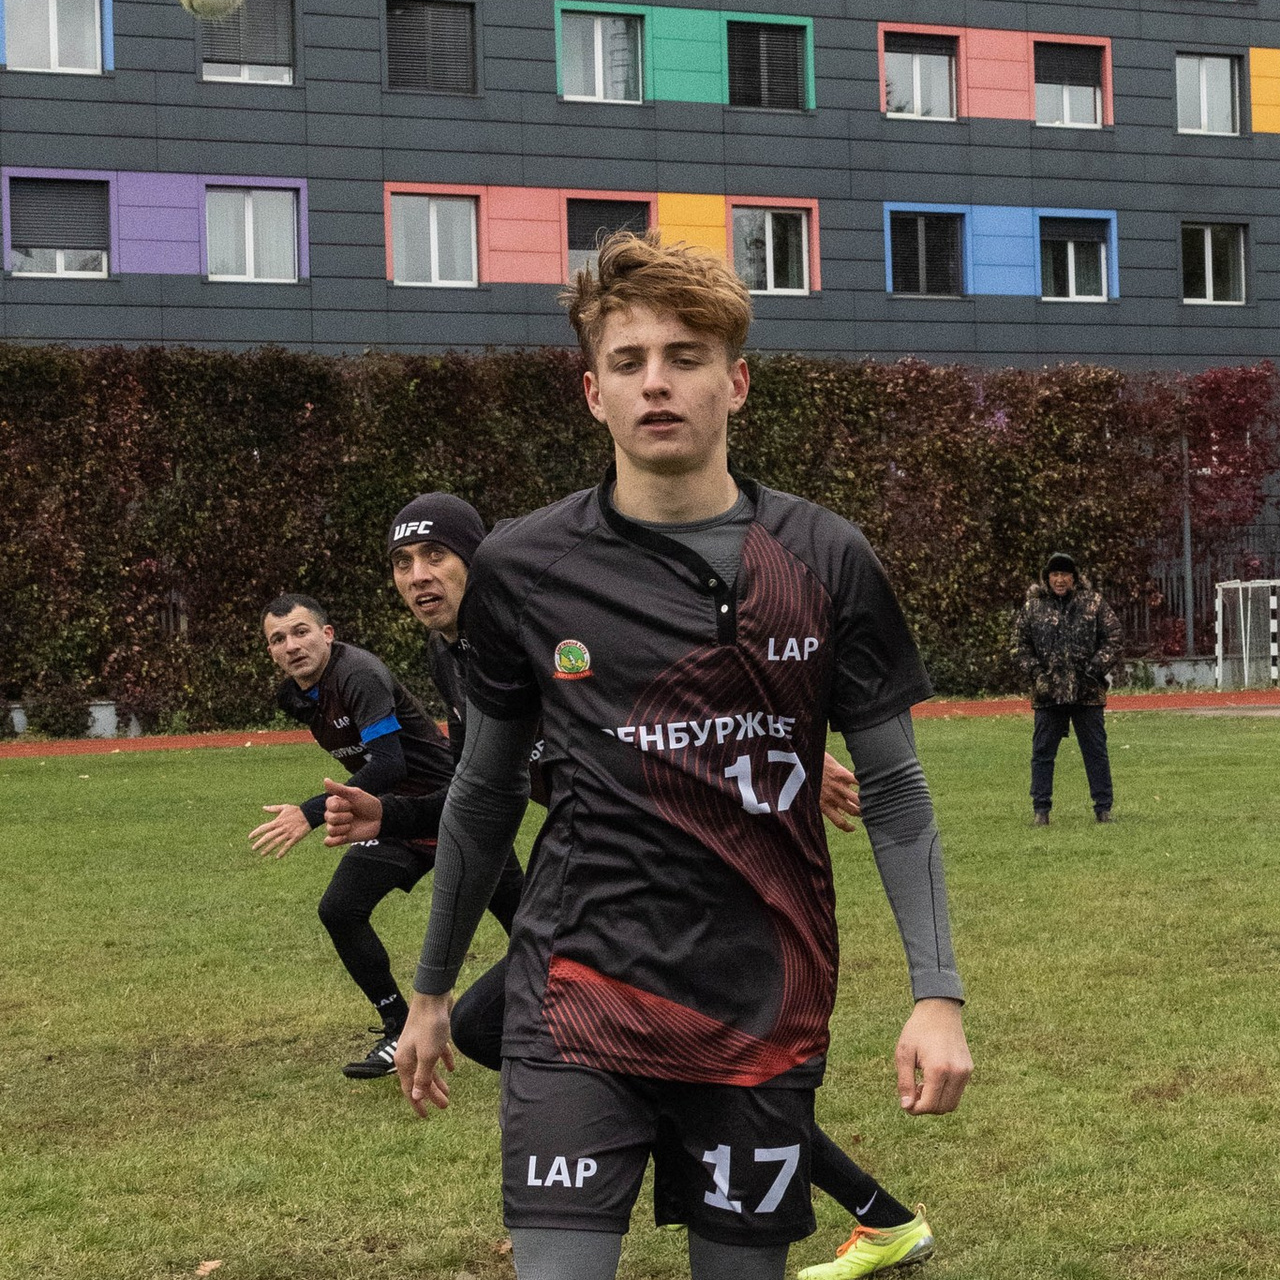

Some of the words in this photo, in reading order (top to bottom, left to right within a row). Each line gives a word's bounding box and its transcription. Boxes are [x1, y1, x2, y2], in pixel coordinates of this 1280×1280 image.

[394, 521, 433, 541] UFC
[767, 637, 819, 661] LAP
[333, 715, 350, 729] LAP
[601, 711, 796, 752] ЕНБУРЖЬЕ
[724, 750, 806, 814] 17
[527, 1155, 598, 1188] LAP
[702, 1143, 800, 1214] 17
